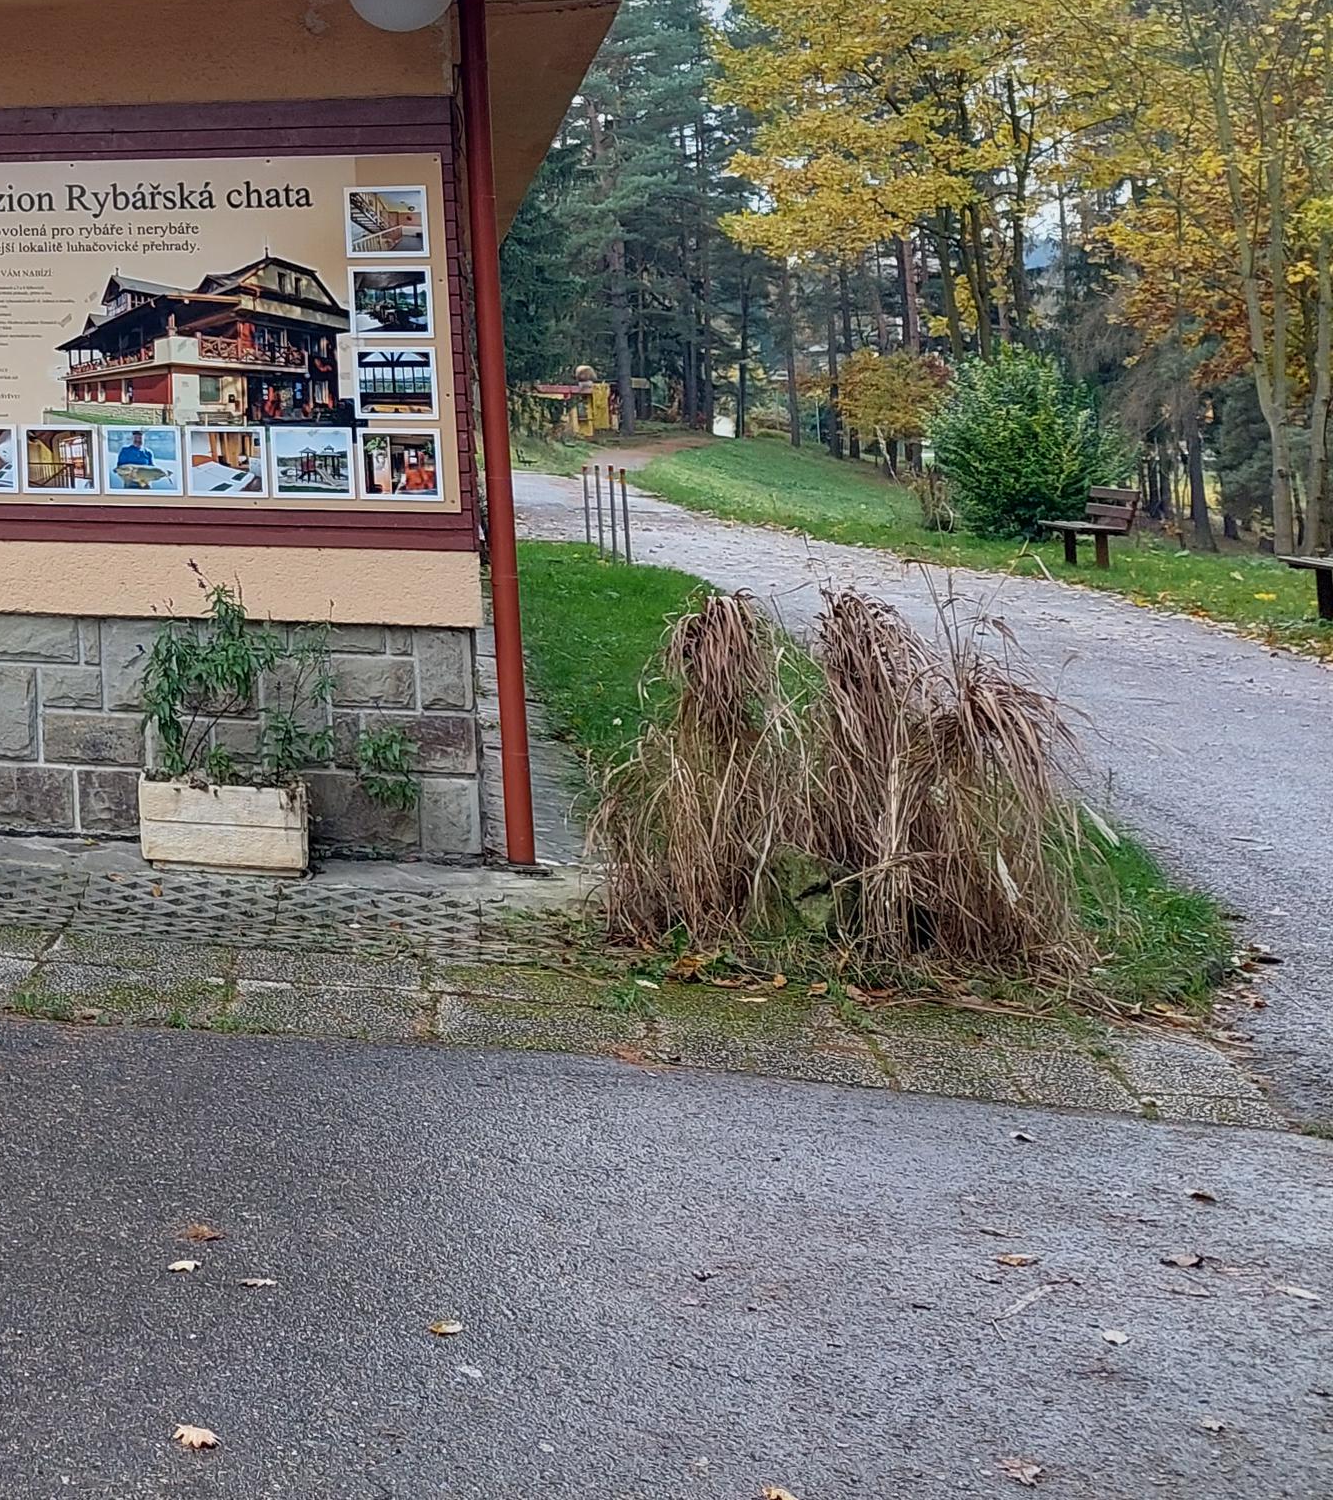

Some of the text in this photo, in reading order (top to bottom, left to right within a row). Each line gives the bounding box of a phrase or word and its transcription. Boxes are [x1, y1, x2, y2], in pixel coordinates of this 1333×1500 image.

[65, 182, 216, 218] Rybářská
[226, 181, 313, 210] chata
[51, 226, 75, 239] pro
[79, 223, 123, 238] rybáře
[128, 223, 132, 235] i
[137, 223, 199, 236] nerybáře
[18, 241, 63, 253] lokalitě
[66, 241, 138, 252] luhačovické
[142, 241, 200, 255] přehrady.
